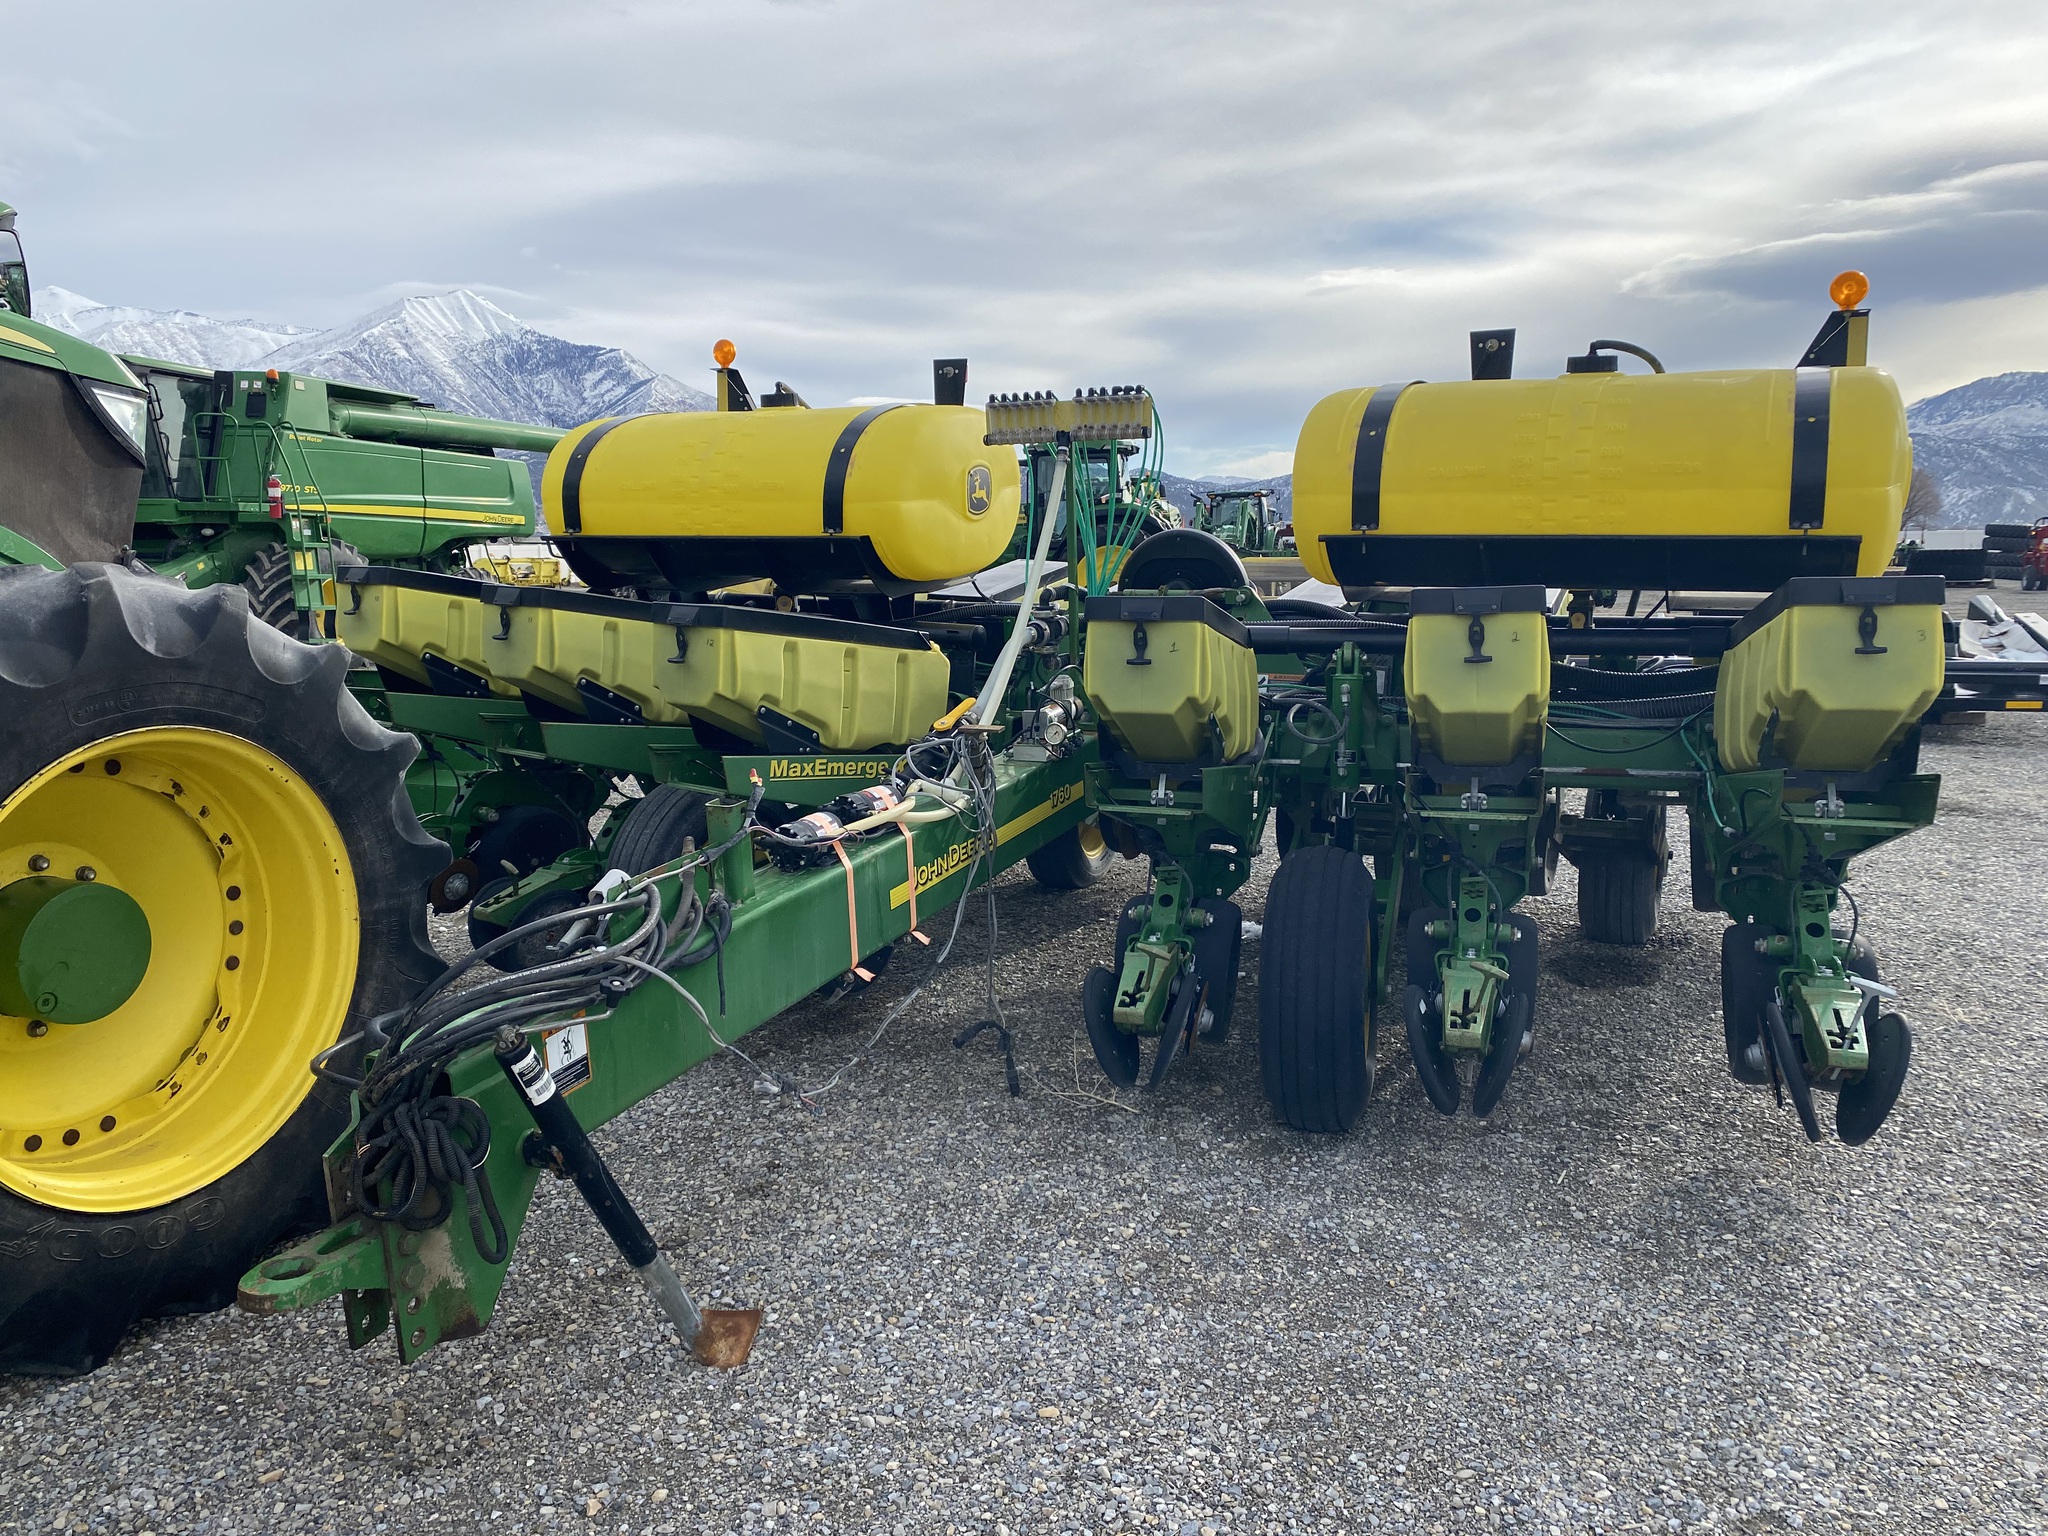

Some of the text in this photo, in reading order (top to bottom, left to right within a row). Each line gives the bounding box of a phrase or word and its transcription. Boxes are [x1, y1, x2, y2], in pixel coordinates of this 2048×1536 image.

[1511, 631, 1521, 643] 2
[1916, 629, 1927, 642] 3
[706, 638, 715, 648] 12
[1169, 641, 1180, 653] 1
[770, 758, 889, 778] MaxEmerge
[1050, 784, 1071, 809] 1760
[913, 832, 995, 891] JOHN DEE
